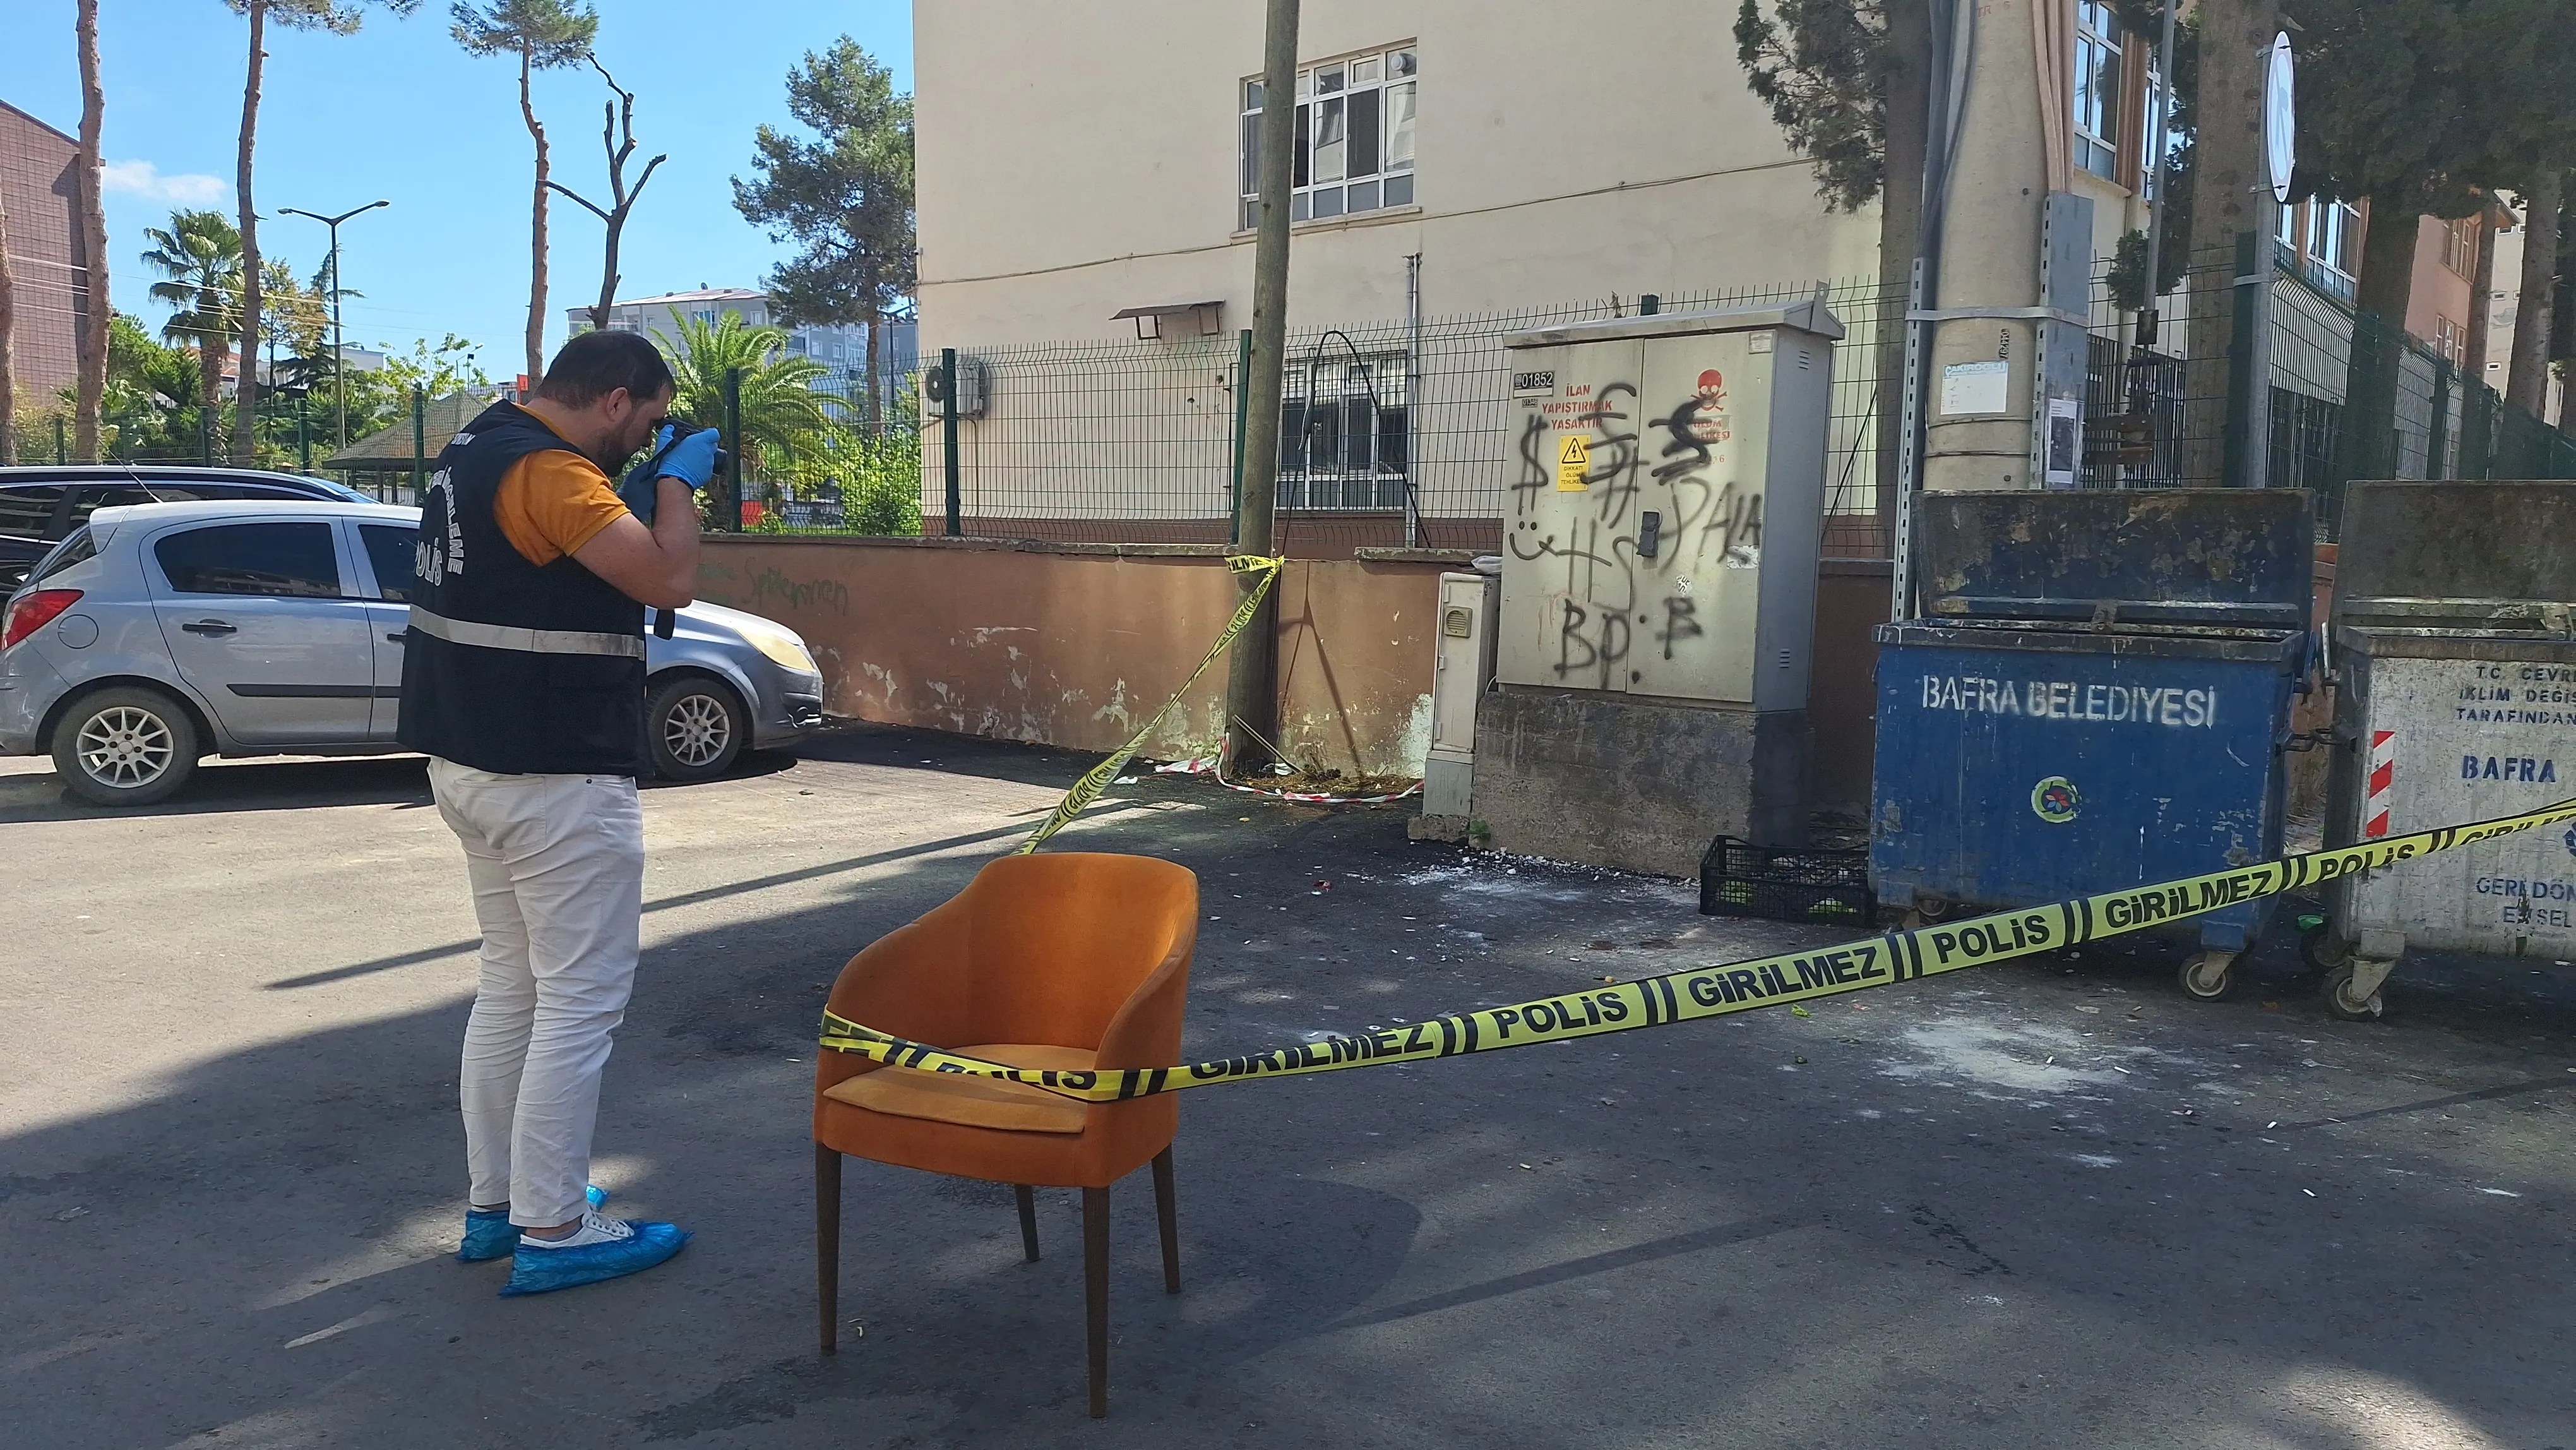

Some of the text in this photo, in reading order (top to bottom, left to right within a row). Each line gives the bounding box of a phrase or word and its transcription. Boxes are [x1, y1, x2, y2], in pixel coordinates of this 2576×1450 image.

[1522, 372, 1553, 387] 01852
[1566, 383, 1590, 397] İLAN
[415, 537, 443, 587] OLİS
[1923, 674, 2020, 714] BAFRA
[2462, 755, 2556, 783] BAFRA
